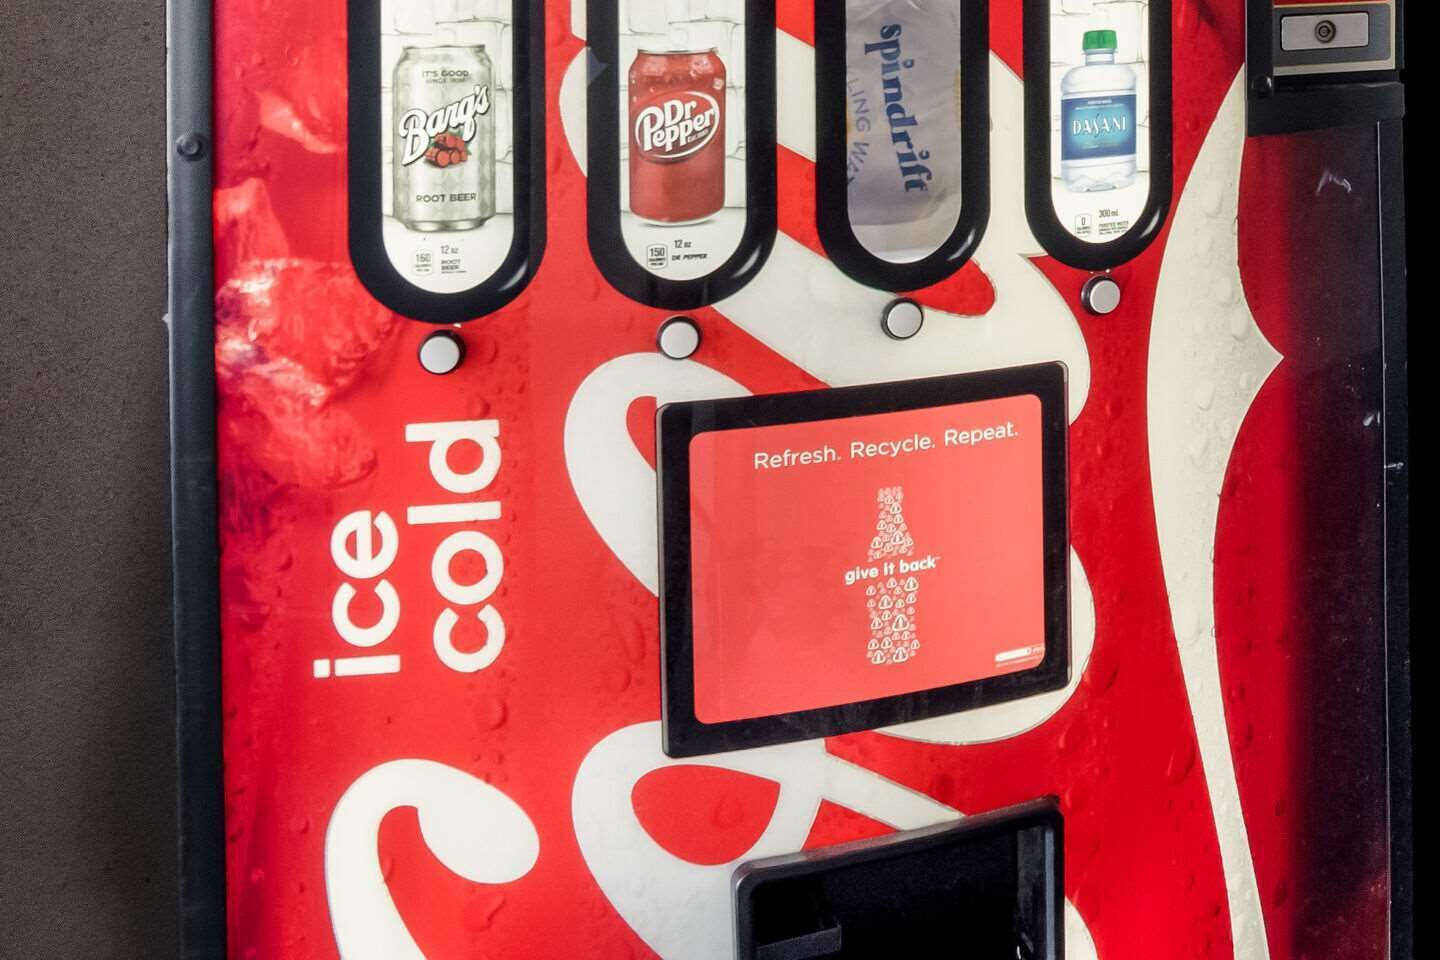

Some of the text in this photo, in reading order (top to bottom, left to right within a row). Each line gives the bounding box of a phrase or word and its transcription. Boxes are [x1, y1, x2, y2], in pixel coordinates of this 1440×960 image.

[398, 83, 492, 167] Barq's
[638, 106, 716, 153] Pepper
[664, 99, 698, 128] Dr
[863, 23, 933, 193] spindrift
[1072, 114, 1127, 136] DASANI
[416, 192, 478, 204] ROOT BEER
[753, 421, 1020, 470] Refresh. Recycle. Repeat.
[405, 418, 506, 673] cold
[313, 509, 401, 679] ice
[844, 555, 938, 585] give it back
